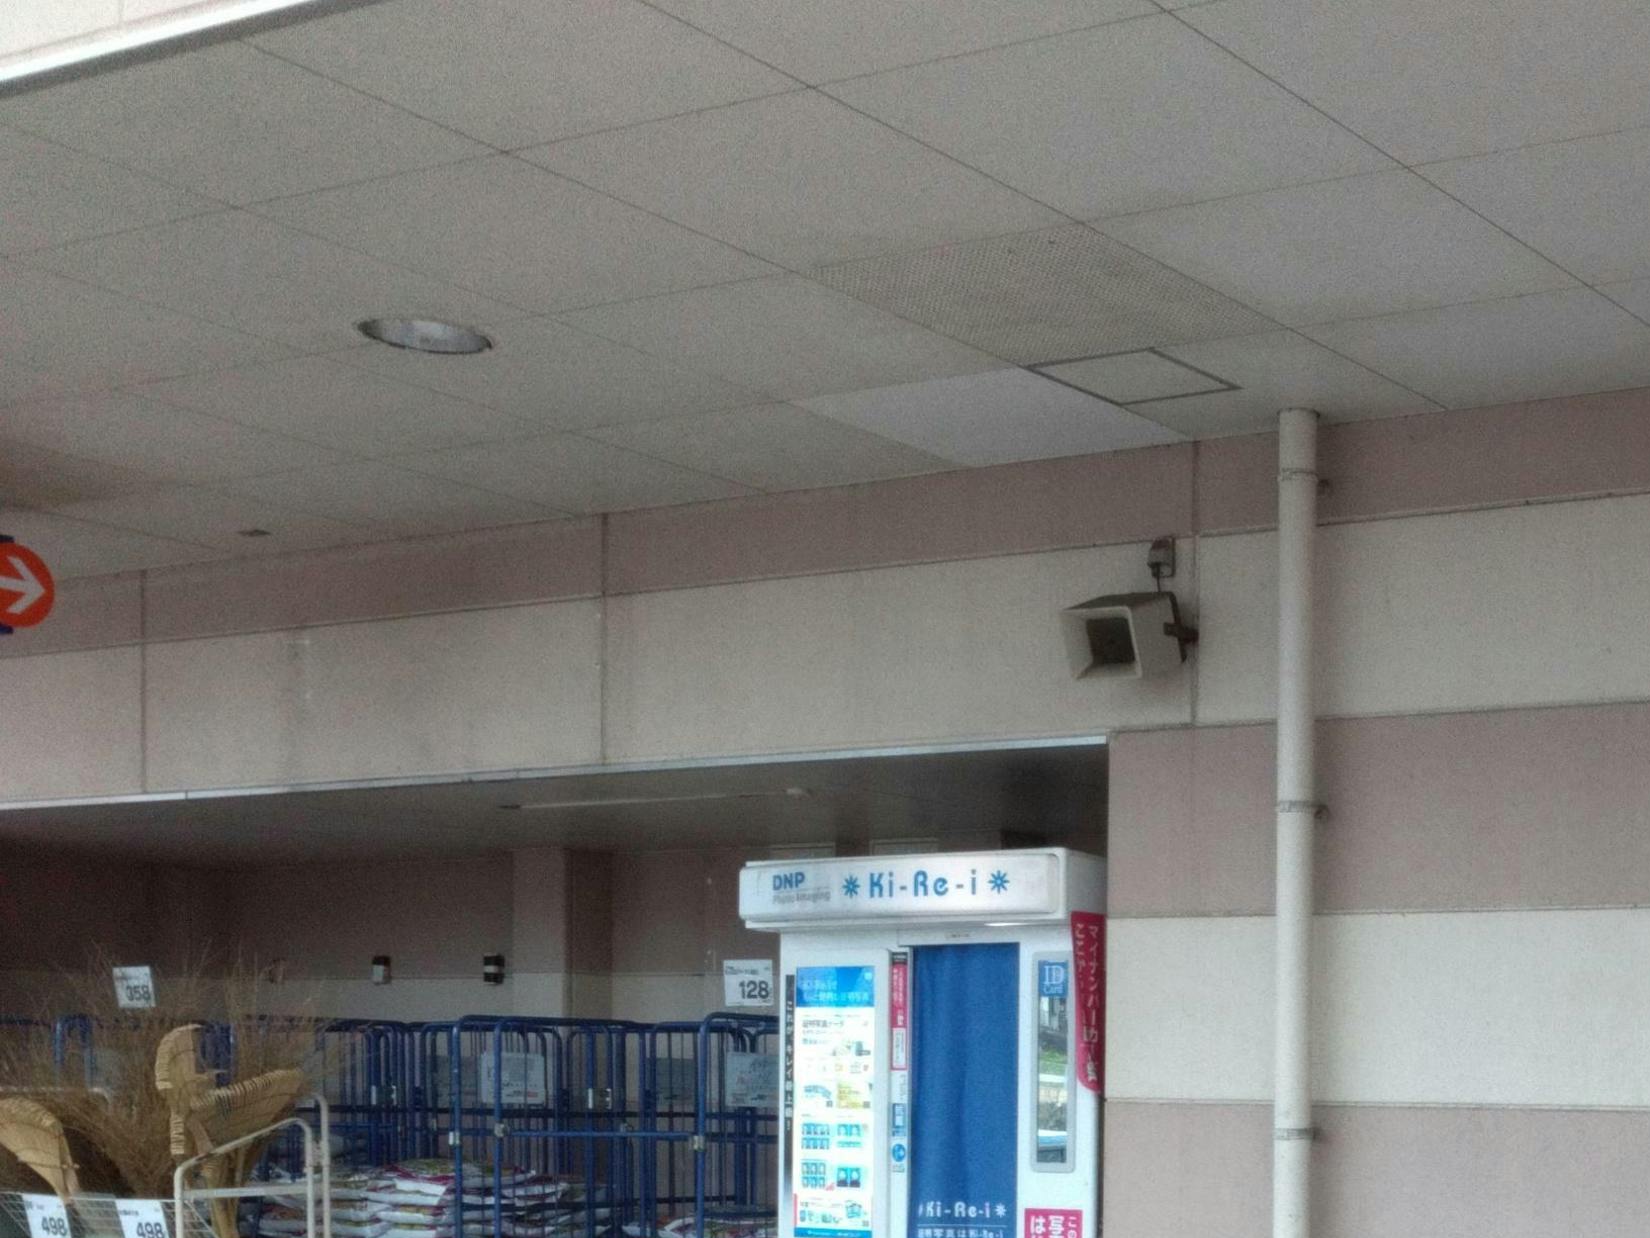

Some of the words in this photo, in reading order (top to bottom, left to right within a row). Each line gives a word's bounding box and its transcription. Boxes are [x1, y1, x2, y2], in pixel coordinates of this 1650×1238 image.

[772, 872, 805, 891] DNP
[1043, 965, 1065, 985] ID
[739, 980, 769, 999] 128
[41, 1215, 68, 1237] 498
